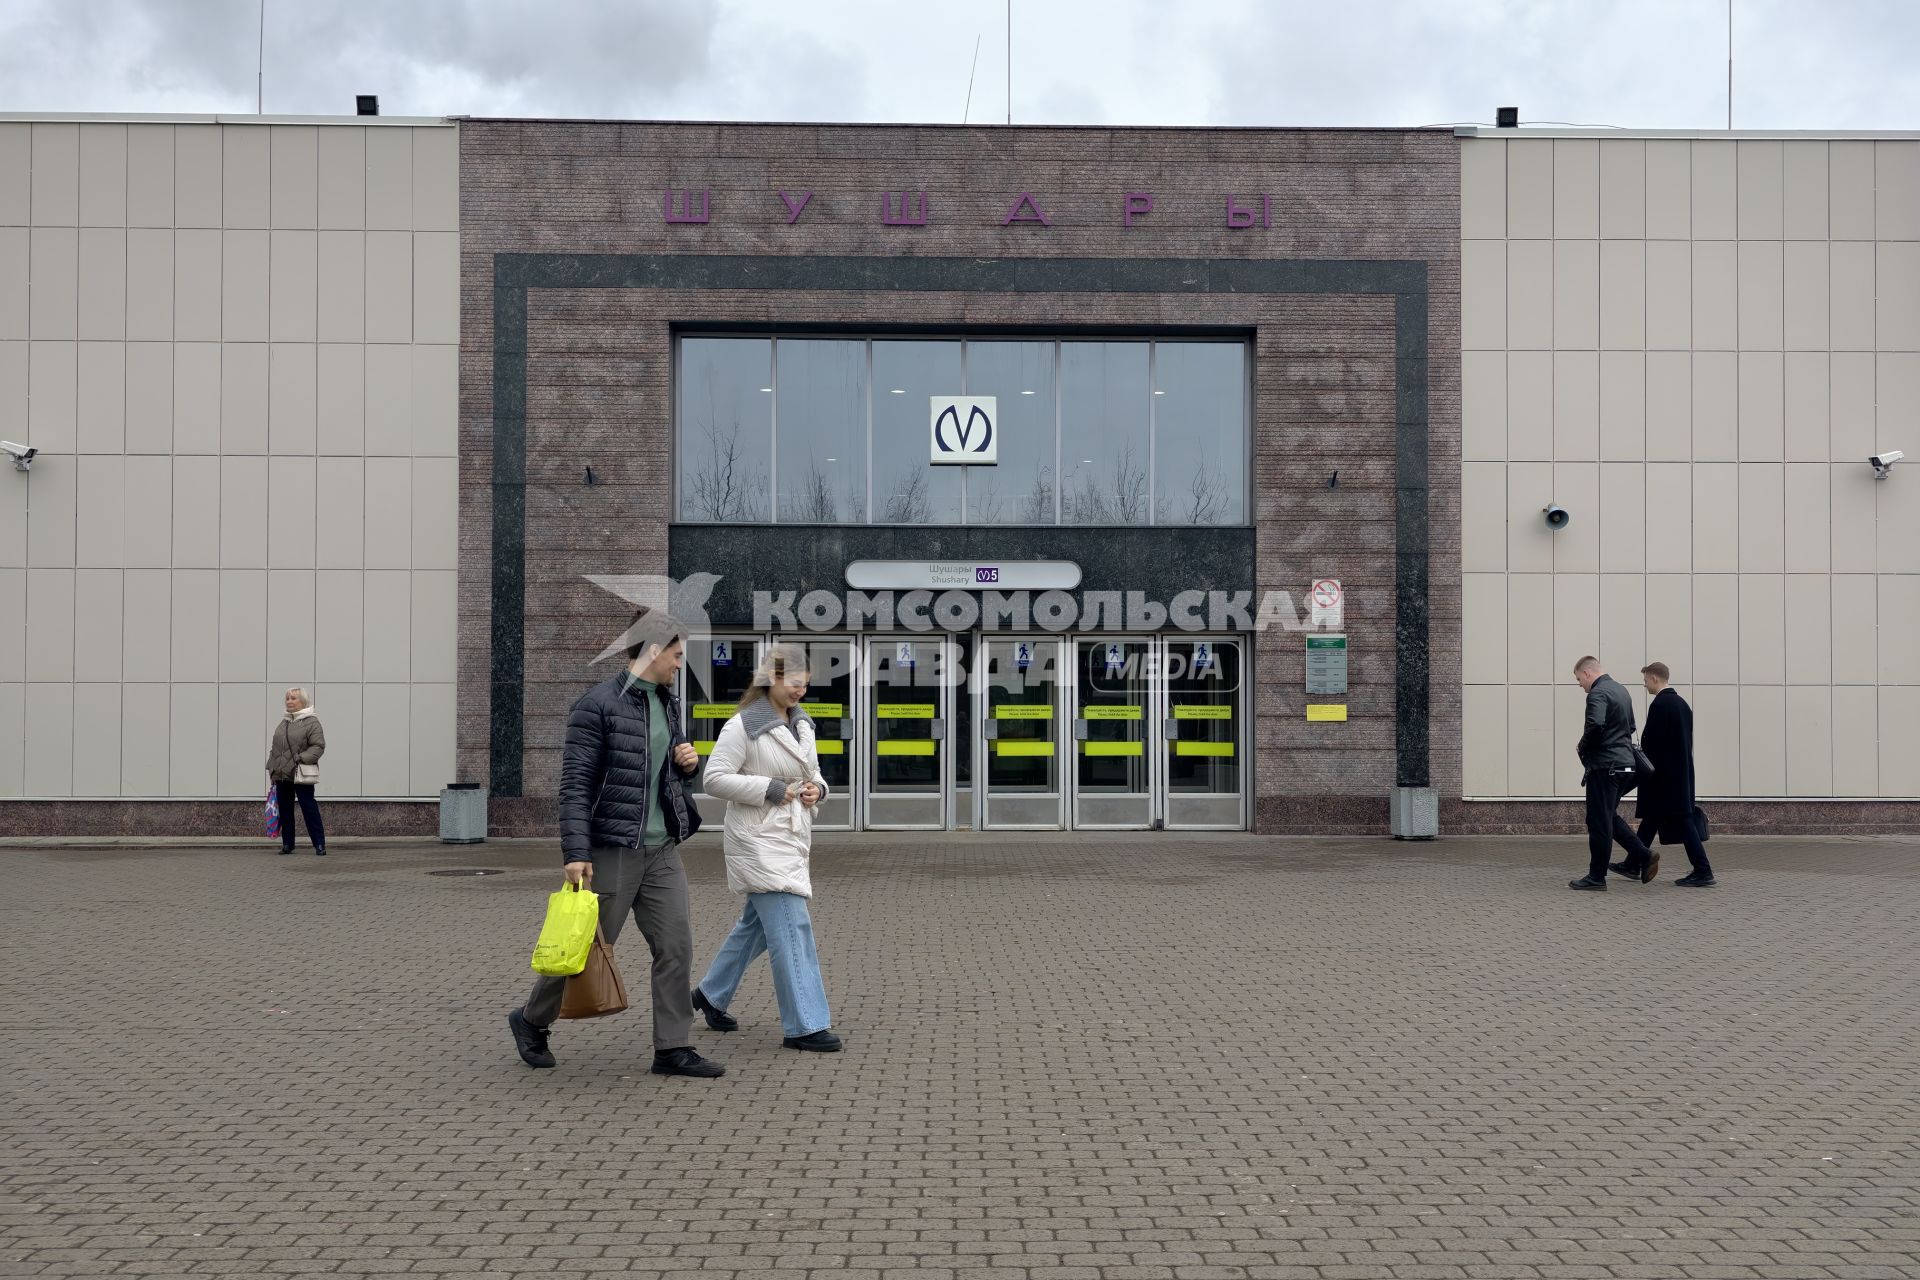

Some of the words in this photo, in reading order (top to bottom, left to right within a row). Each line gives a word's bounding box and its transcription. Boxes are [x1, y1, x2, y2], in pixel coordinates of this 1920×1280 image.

[664, 188, 1271, 229] ШУШАРЫ
[929, 564, 972, 575] Шушары
[931, 576, 970, 585] Shushary
